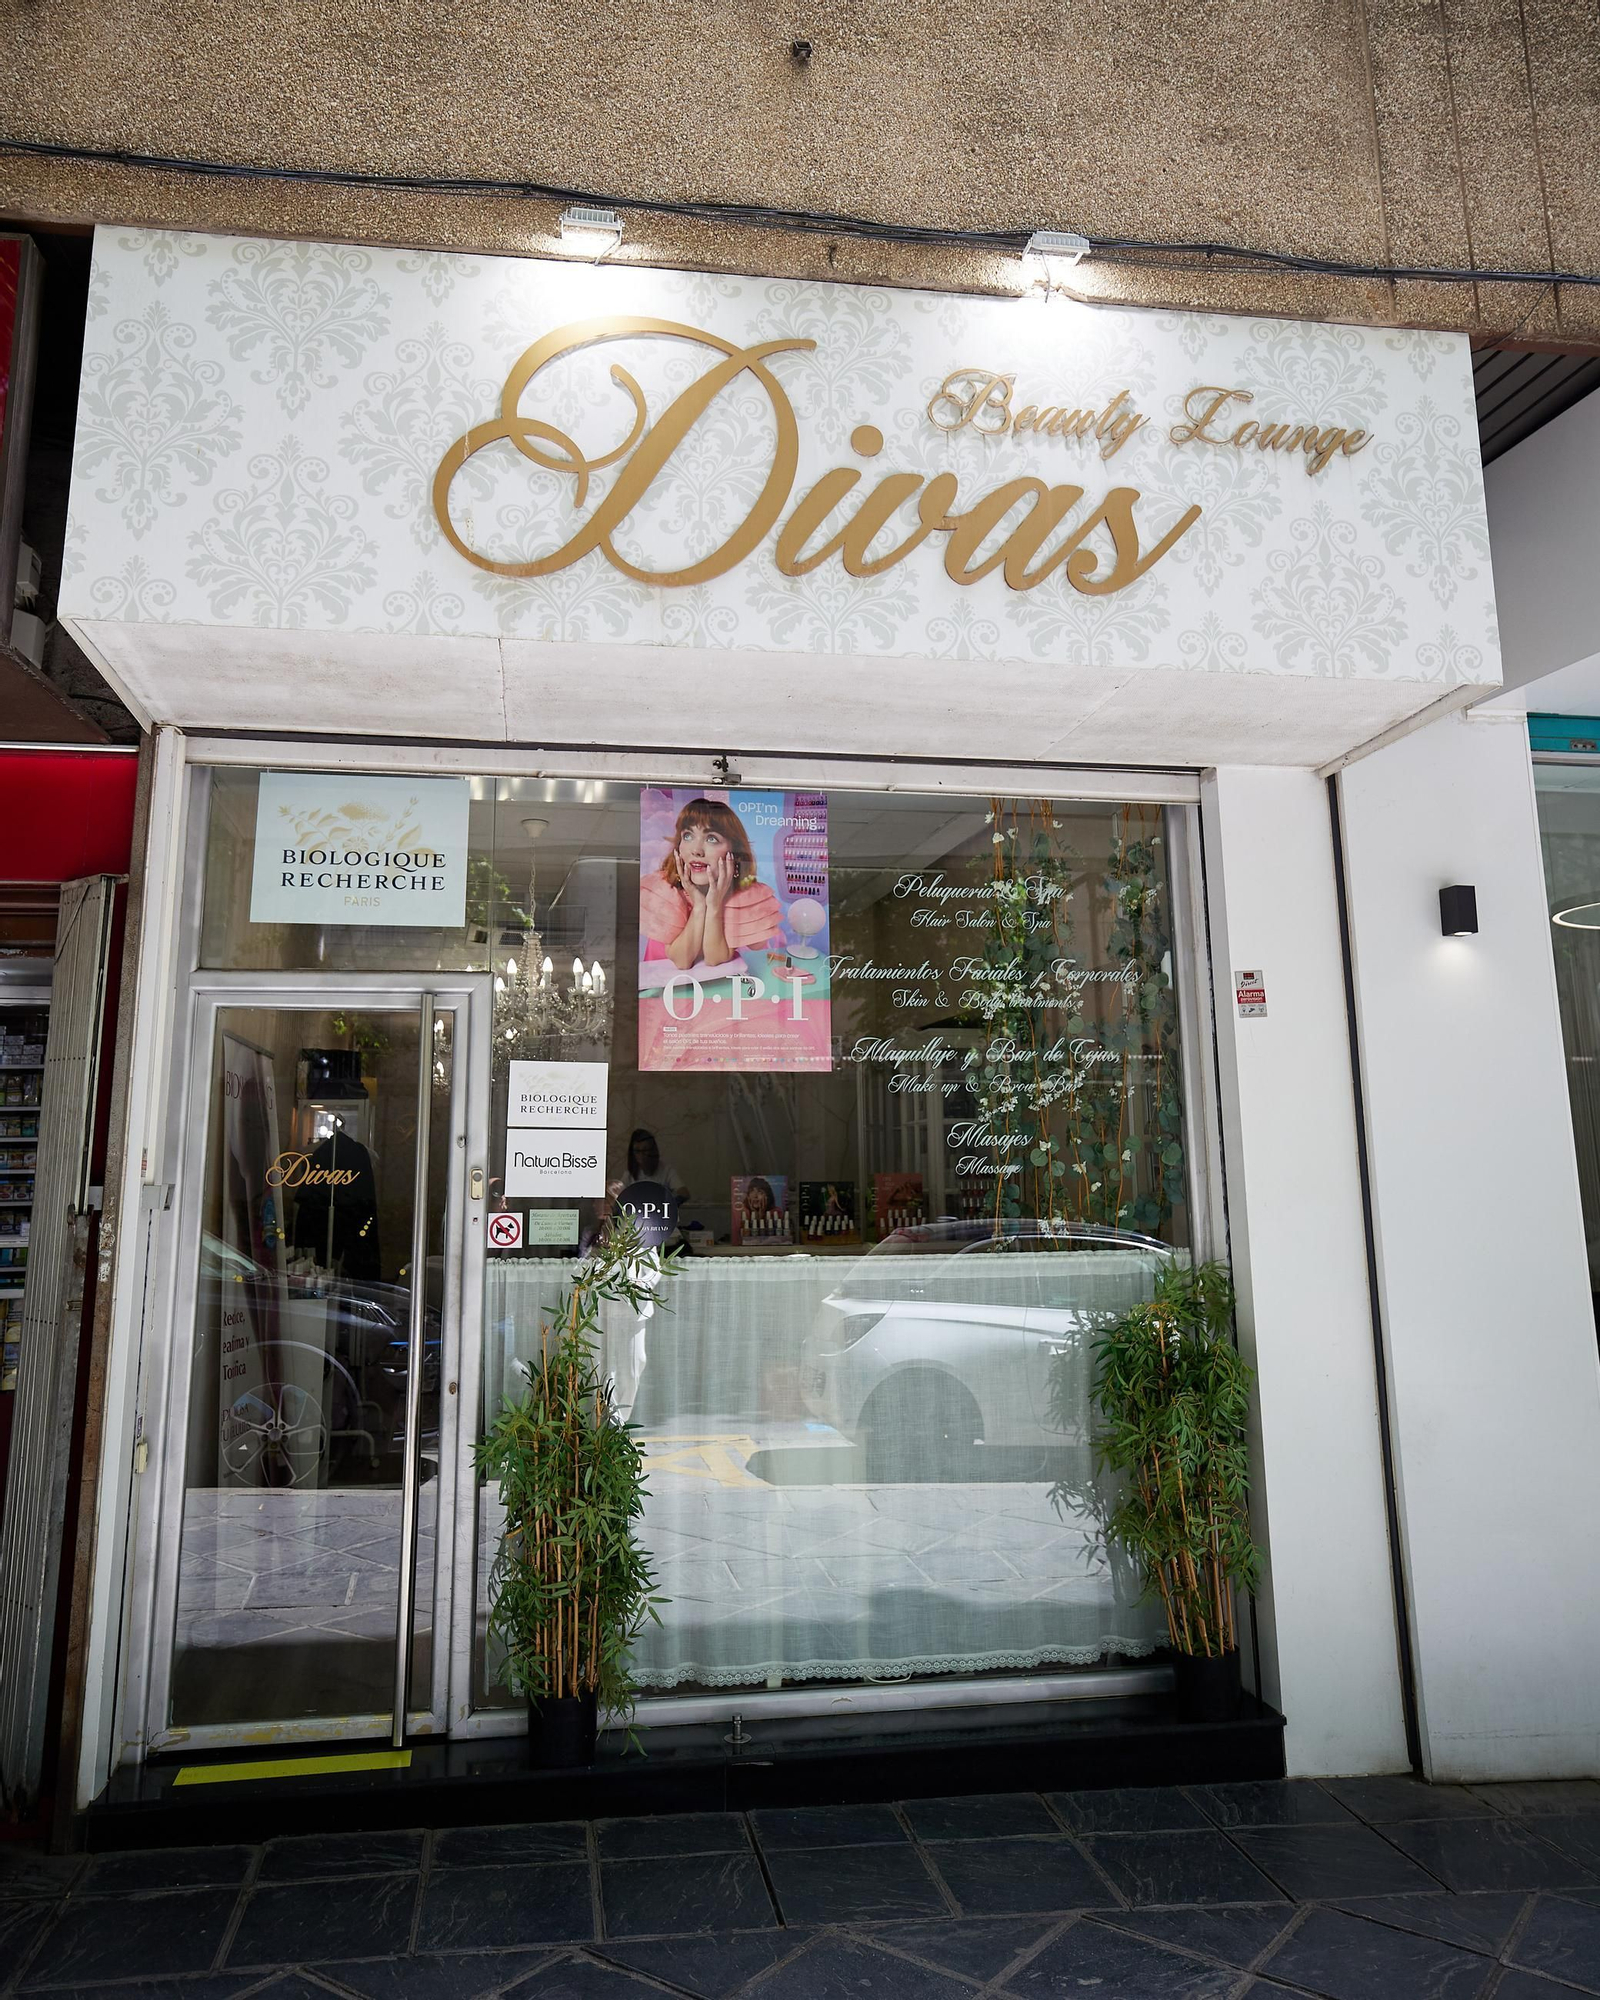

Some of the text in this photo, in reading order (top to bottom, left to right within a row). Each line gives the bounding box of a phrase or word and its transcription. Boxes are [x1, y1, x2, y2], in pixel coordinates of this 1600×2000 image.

[927, 368, 1376, 476] Beauty Lounge
[433, 315, 1201, 595] Divas
[738, 802, 778, 814] OPI'm
[755, 815, 818, 831] Dreaming
[282, 849, 447, 872] BIOLOGIQUE
[281, 872, 446, 891] RECHERCHE
[1001, 878, 1022, 900] &
[1025, 875, 1066, 905] Spa
[344, 896, 381, 907] PARIS
[910, 908, 952, 928] Hair
[1002, 912, 1018, 928] &
[1022, 911, 1053, 934] Spa
[820, 955, 1144, 990] Tratamientos Faciales y Corporales
[892, 988, 930, 1008] Skin
[935, 990, 950, 1008] &
[958, 990, 1006, 1010] Body
[851, 1036, 958, 1070] Maquillaje
[960, 1051, 979, 1071] y
[986, 1038, 1038, 1063] Bar
[1042, 1037, 1066, 1062] de
[888, 1074, 1080, 1098] Make up & Brow Bar
[520, 1094, 598, 1105] BIOLOGIQUE
[520, 1105, 598, 1115] RECHERCHE
[946, 1122, 1034, 1154] Masajes
[266, 1152, 360, 1188] Divas
[514, 1152, 560, 1168] Natura
[956, 1156, 1023, 1179] Massage
